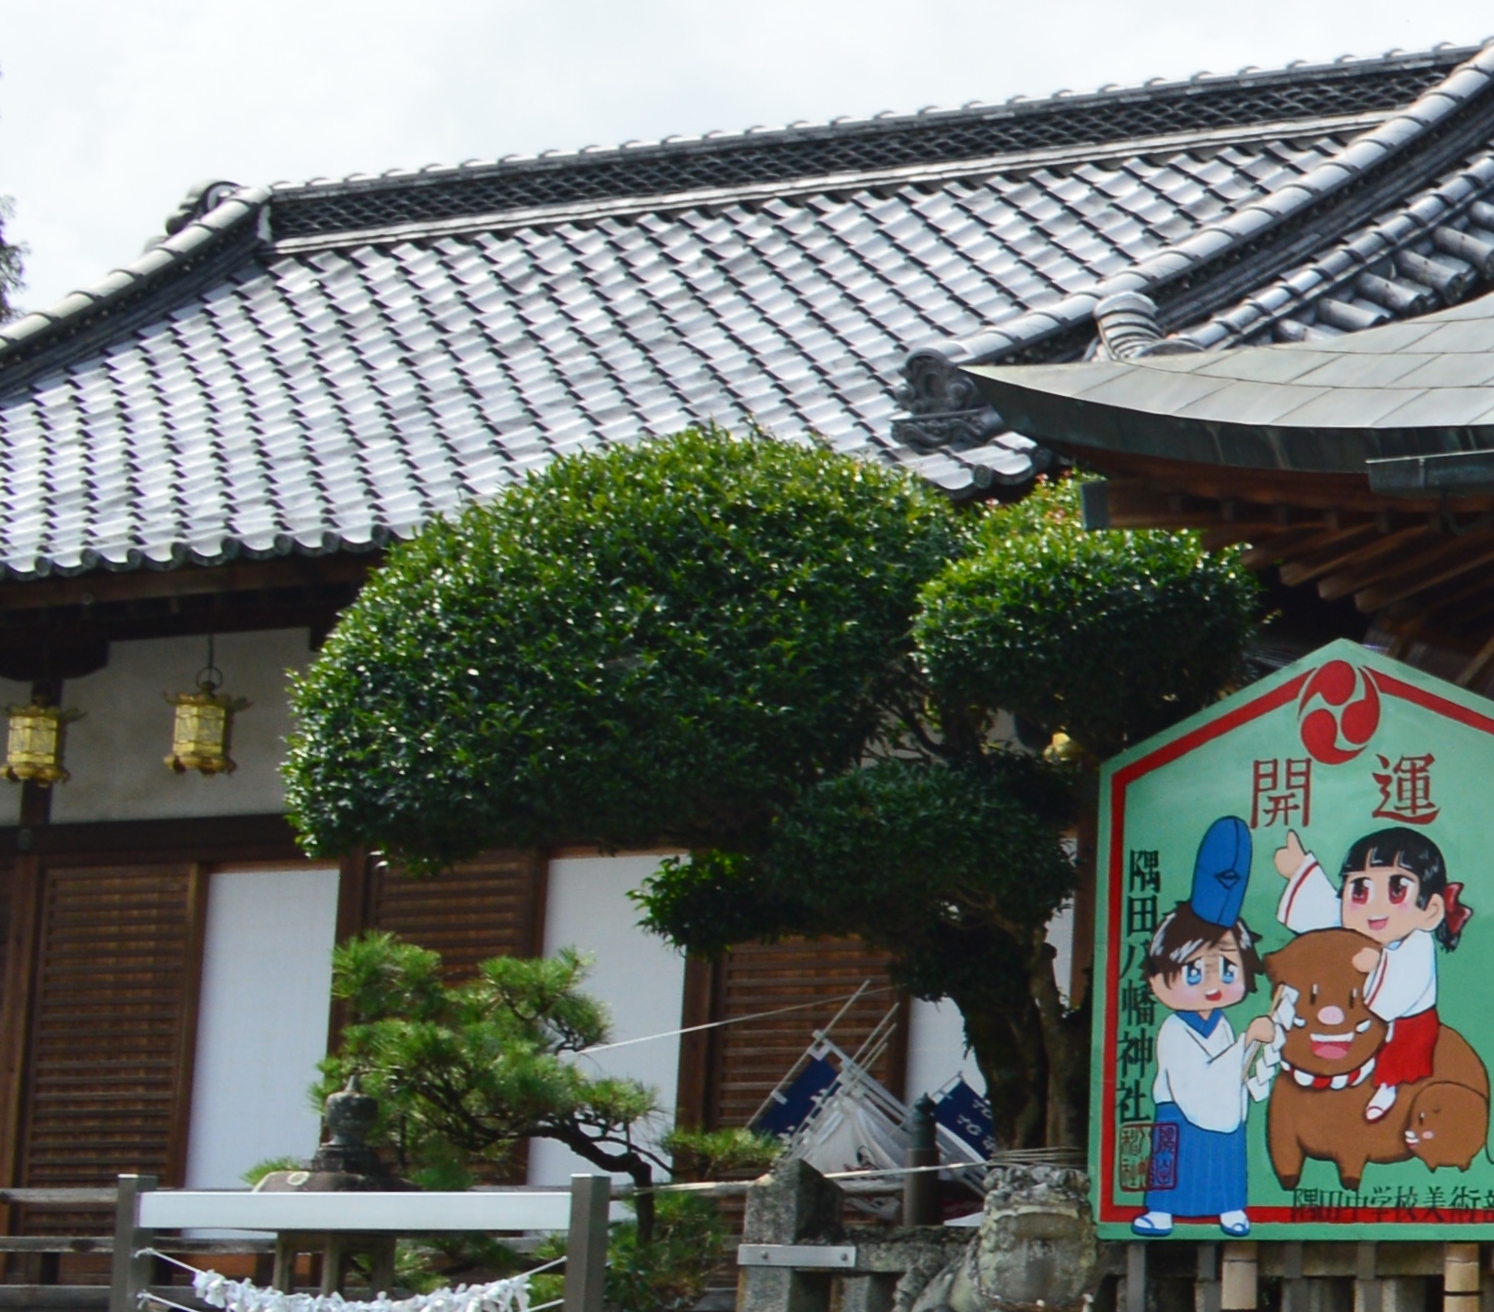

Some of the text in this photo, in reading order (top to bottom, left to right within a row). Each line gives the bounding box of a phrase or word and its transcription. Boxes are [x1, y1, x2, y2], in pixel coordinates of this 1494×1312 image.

[1251, 753, 1441, 829] 開運
[1115, 849, 1161, 1123] 隅田八幡神社
